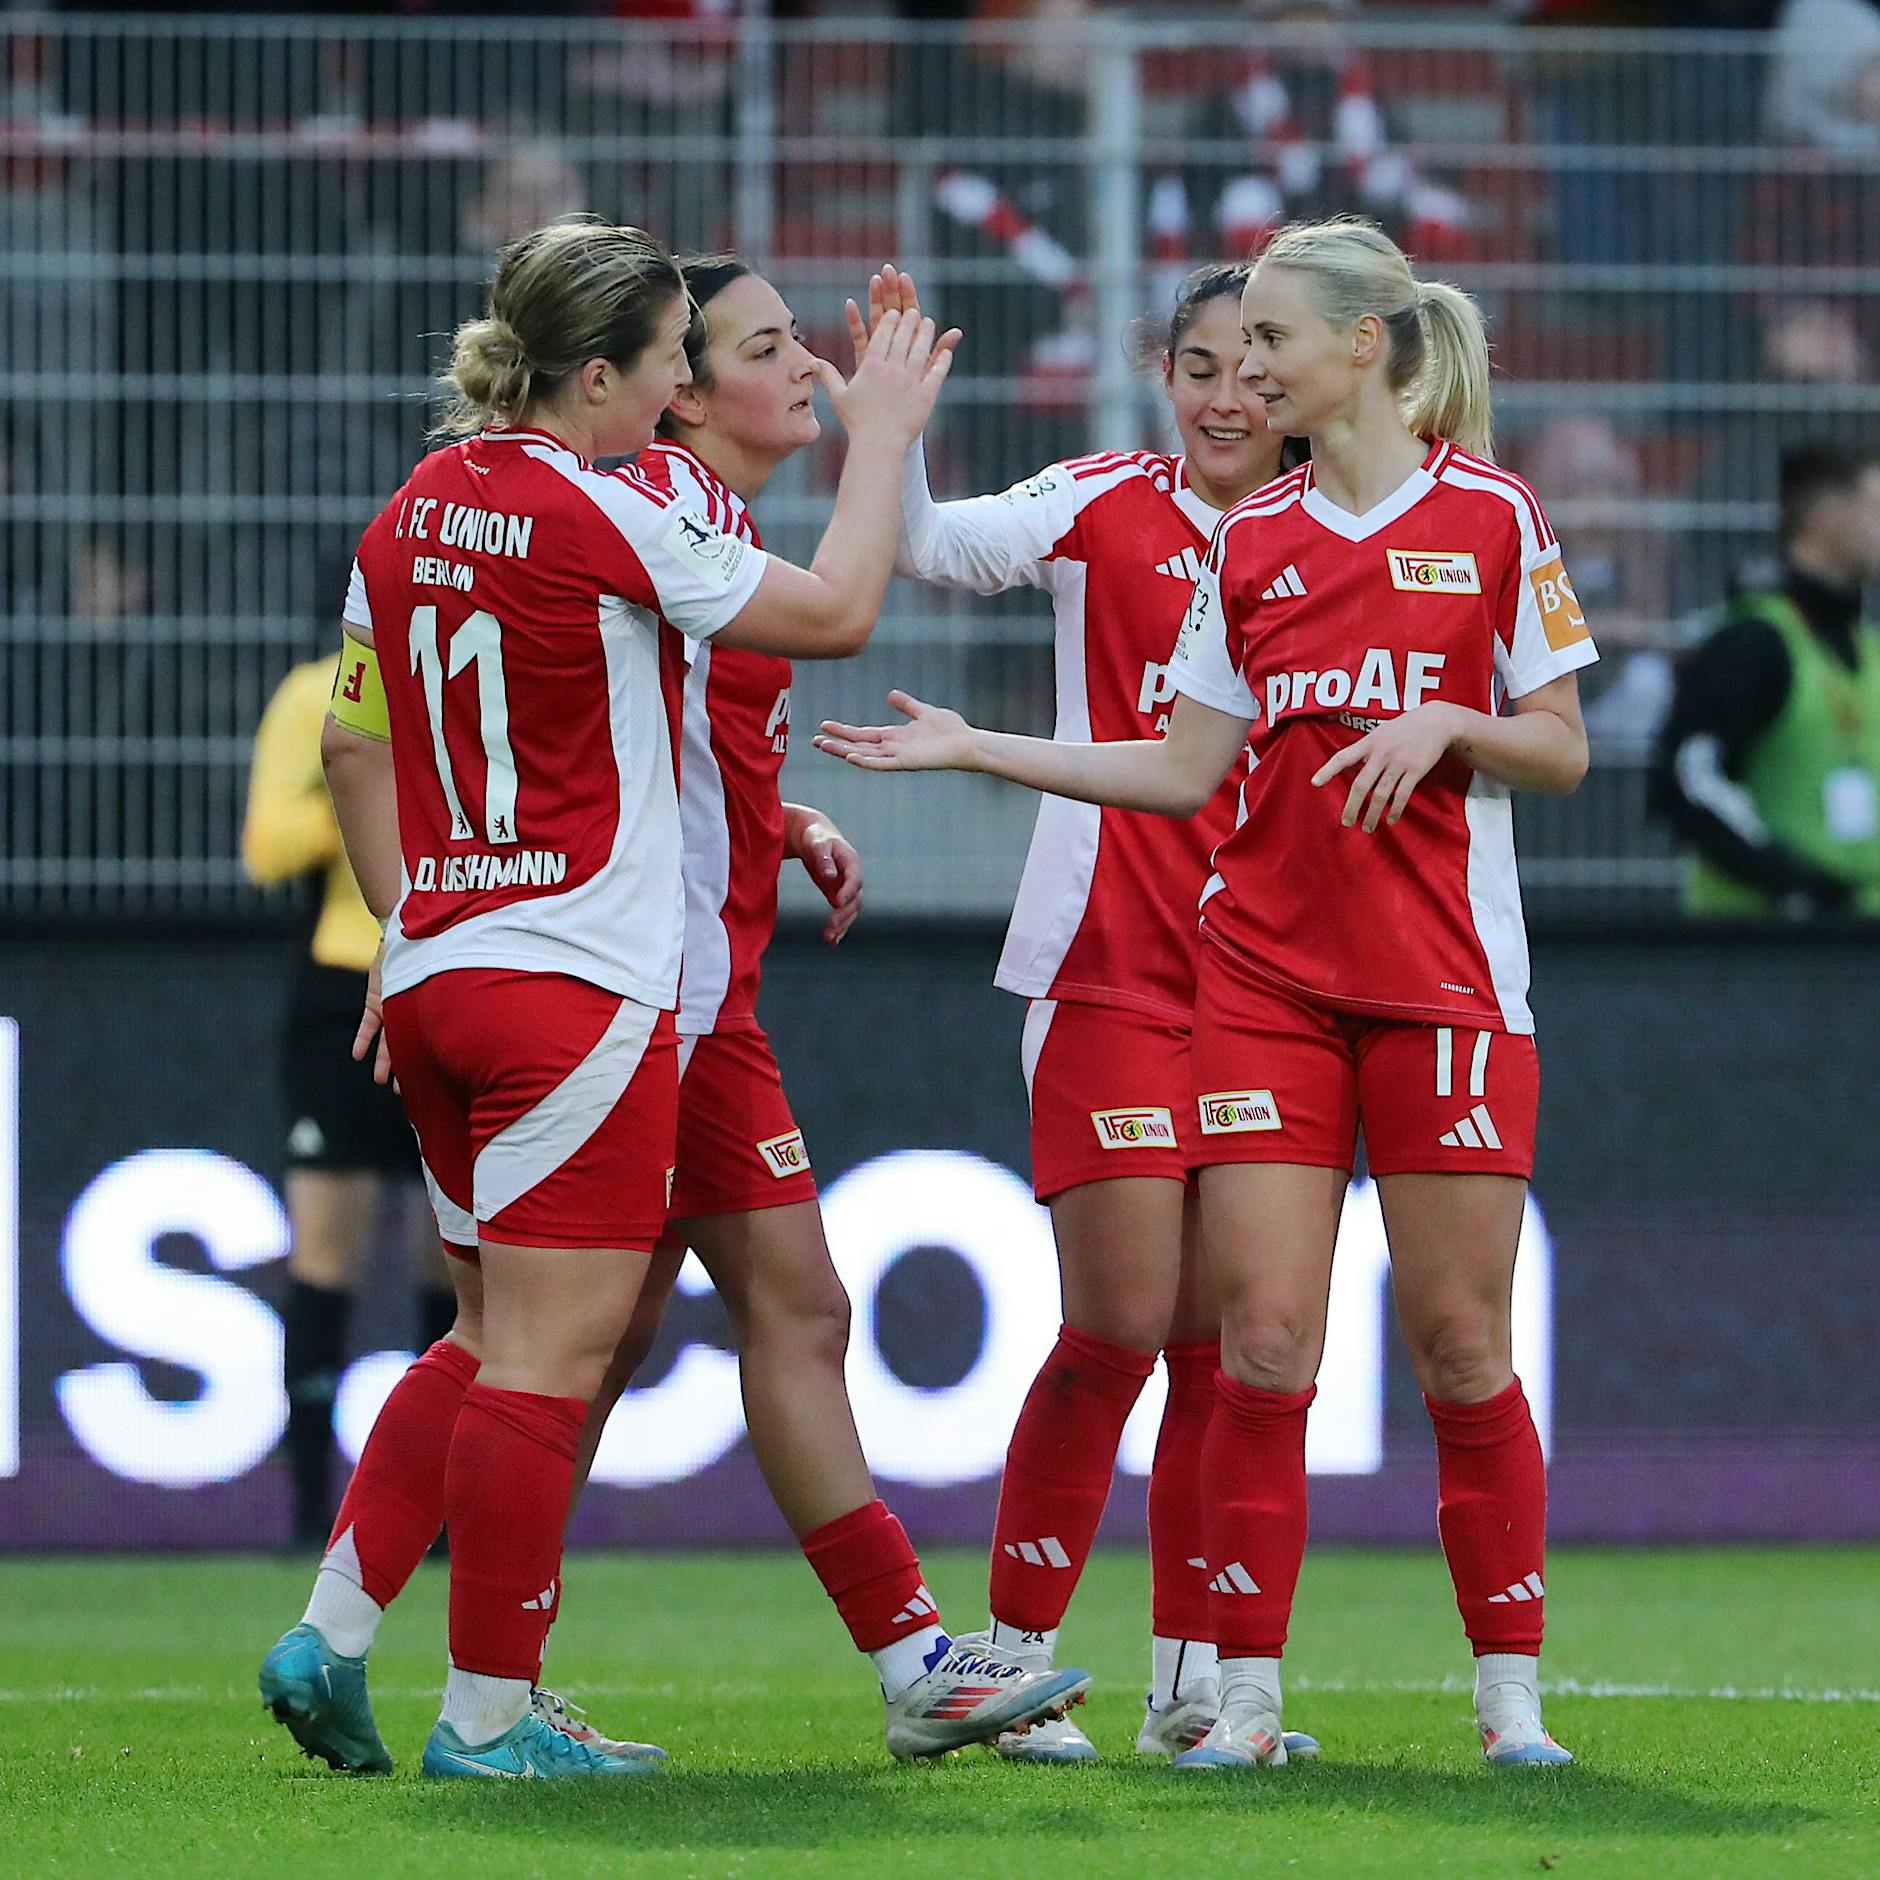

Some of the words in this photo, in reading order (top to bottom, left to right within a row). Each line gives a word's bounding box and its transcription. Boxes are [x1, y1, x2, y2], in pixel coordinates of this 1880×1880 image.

[408, 497, 438, 539] FC
[439, 502, 534, 559] UNION
[412, 556, 475, 593] BERLIN
[1439, 568, 1472, 583] UNION
[1266, 647, 1446, 729] proAF
[408, 605, 519, 845] 11
[413, 856, 437, 893] D.
[1143, 1124, 1169, 1138] UNION
[1237, 1106, 1271, 1122] UNION
[1021, 1630, 1045, 1644] 24
